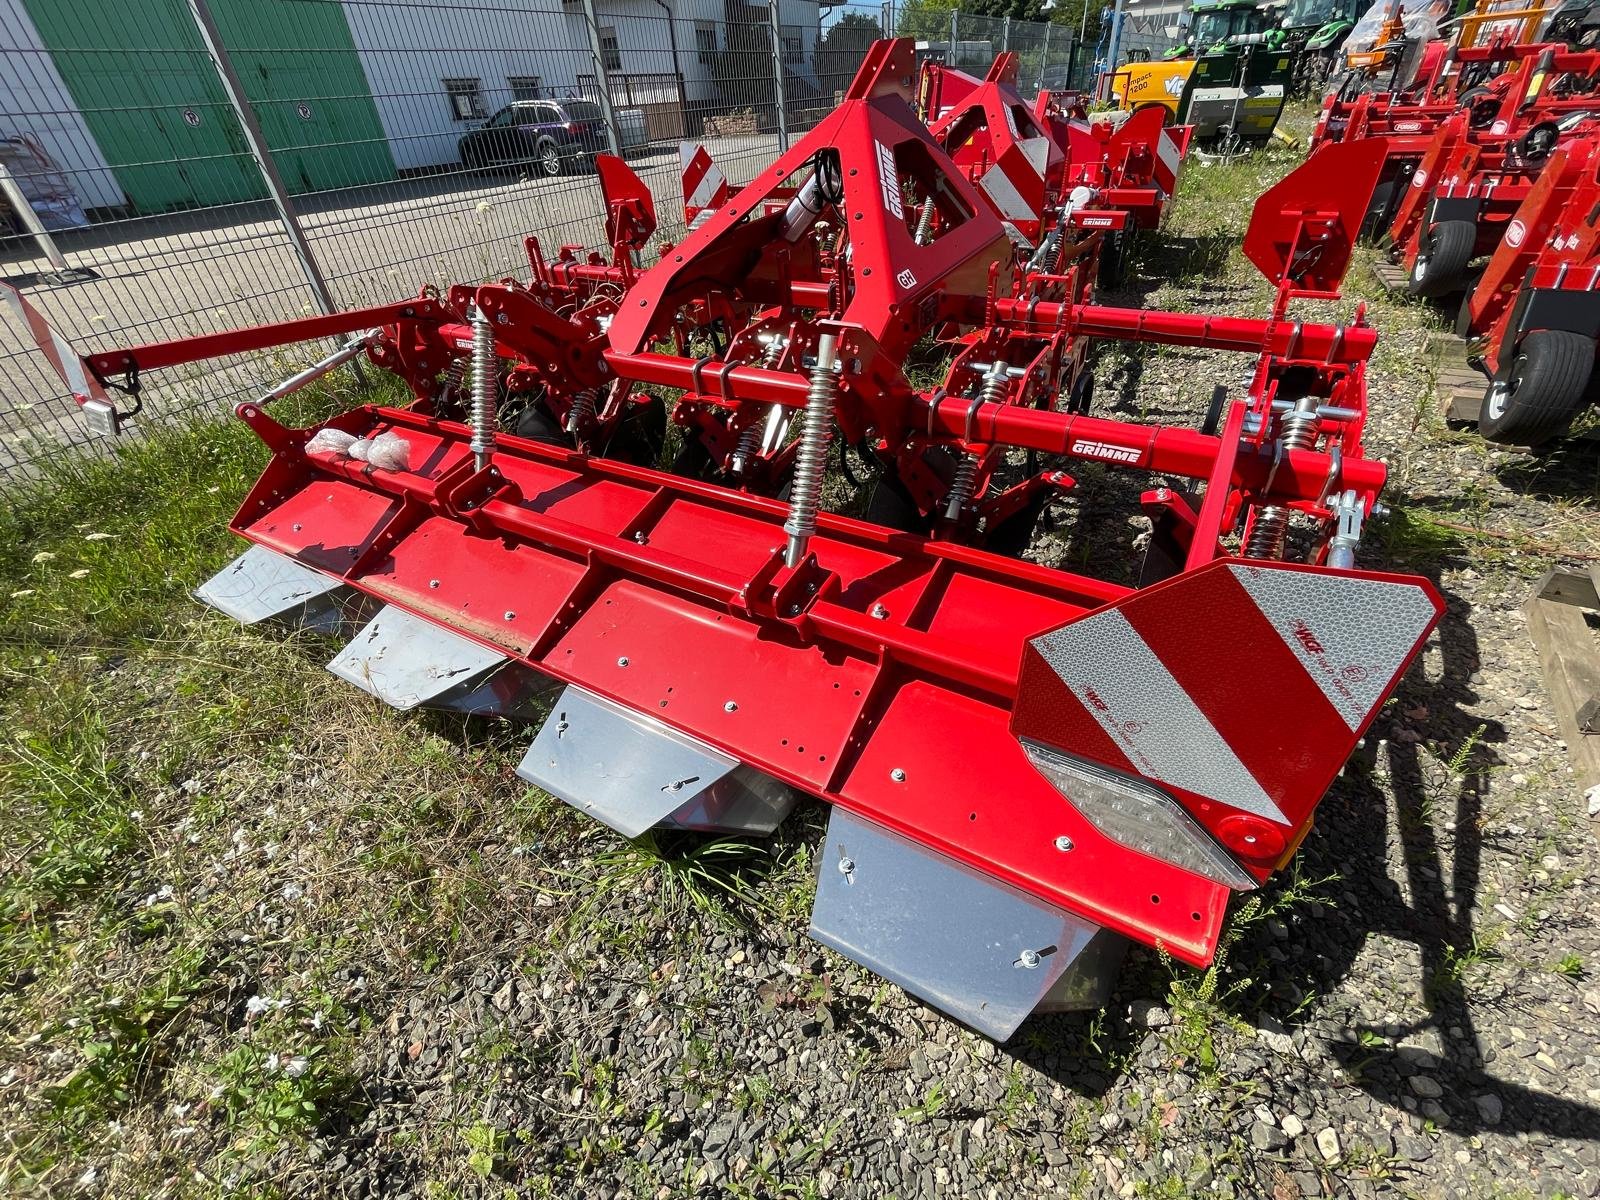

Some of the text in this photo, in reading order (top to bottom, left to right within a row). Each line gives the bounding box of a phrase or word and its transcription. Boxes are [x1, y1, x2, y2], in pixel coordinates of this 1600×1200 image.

[1122, 72, 1153, 89] cmpact
[1130, 81, 1148, 94] 1200
[875, 139, 903, 220] GRIMME
[1082, 217, 1112, 226] GRIMME
[456, 338, 475, 350] GRIM
[1072, 439, 1142, 463] GRIMME
